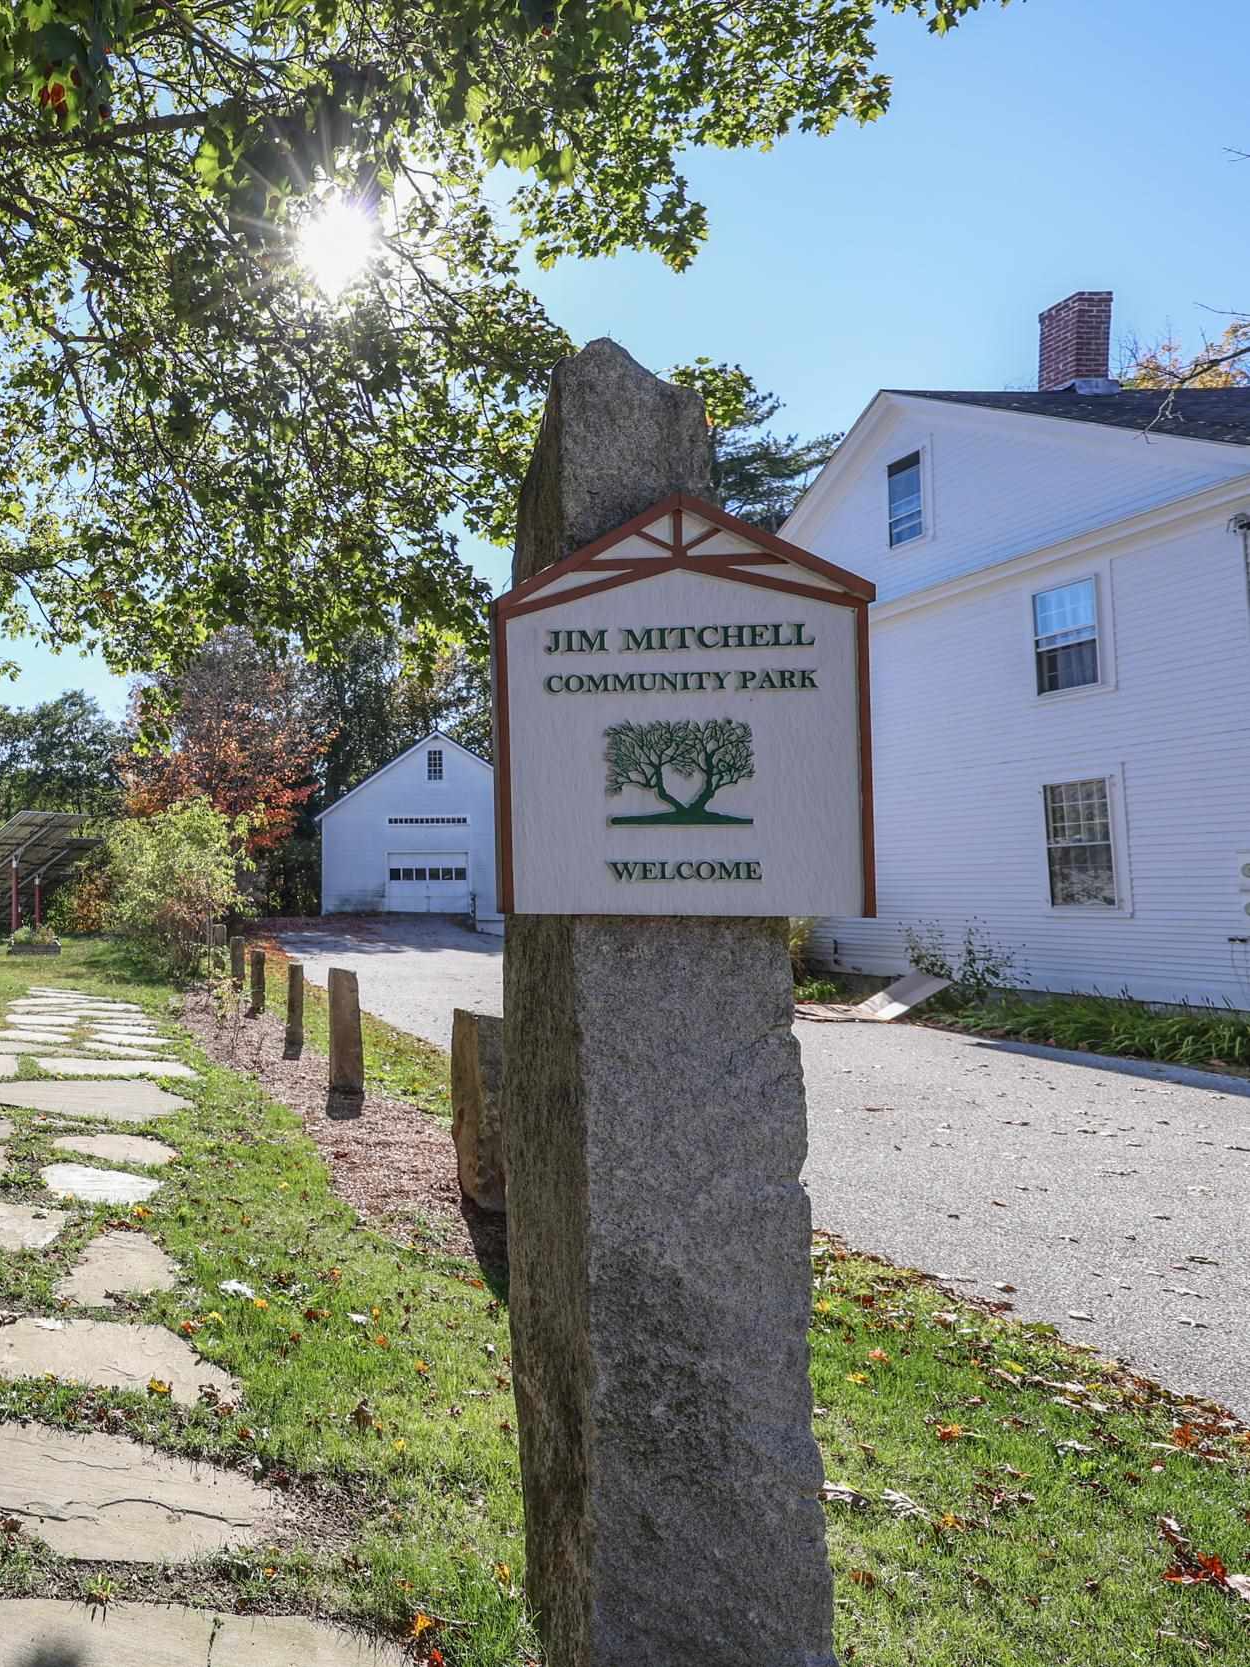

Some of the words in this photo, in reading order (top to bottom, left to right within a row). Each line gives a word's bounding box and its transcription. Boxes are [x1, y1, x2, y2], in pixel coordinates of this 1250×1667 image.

[547, 628, 609, 653] JIM
[622, 623, 816, 650] MITCHELL
[546, 670, 730, 693] COMMUNITY
[740, 669, 818, 690] PARK
[609, 861, 762, 881] WELCOME
